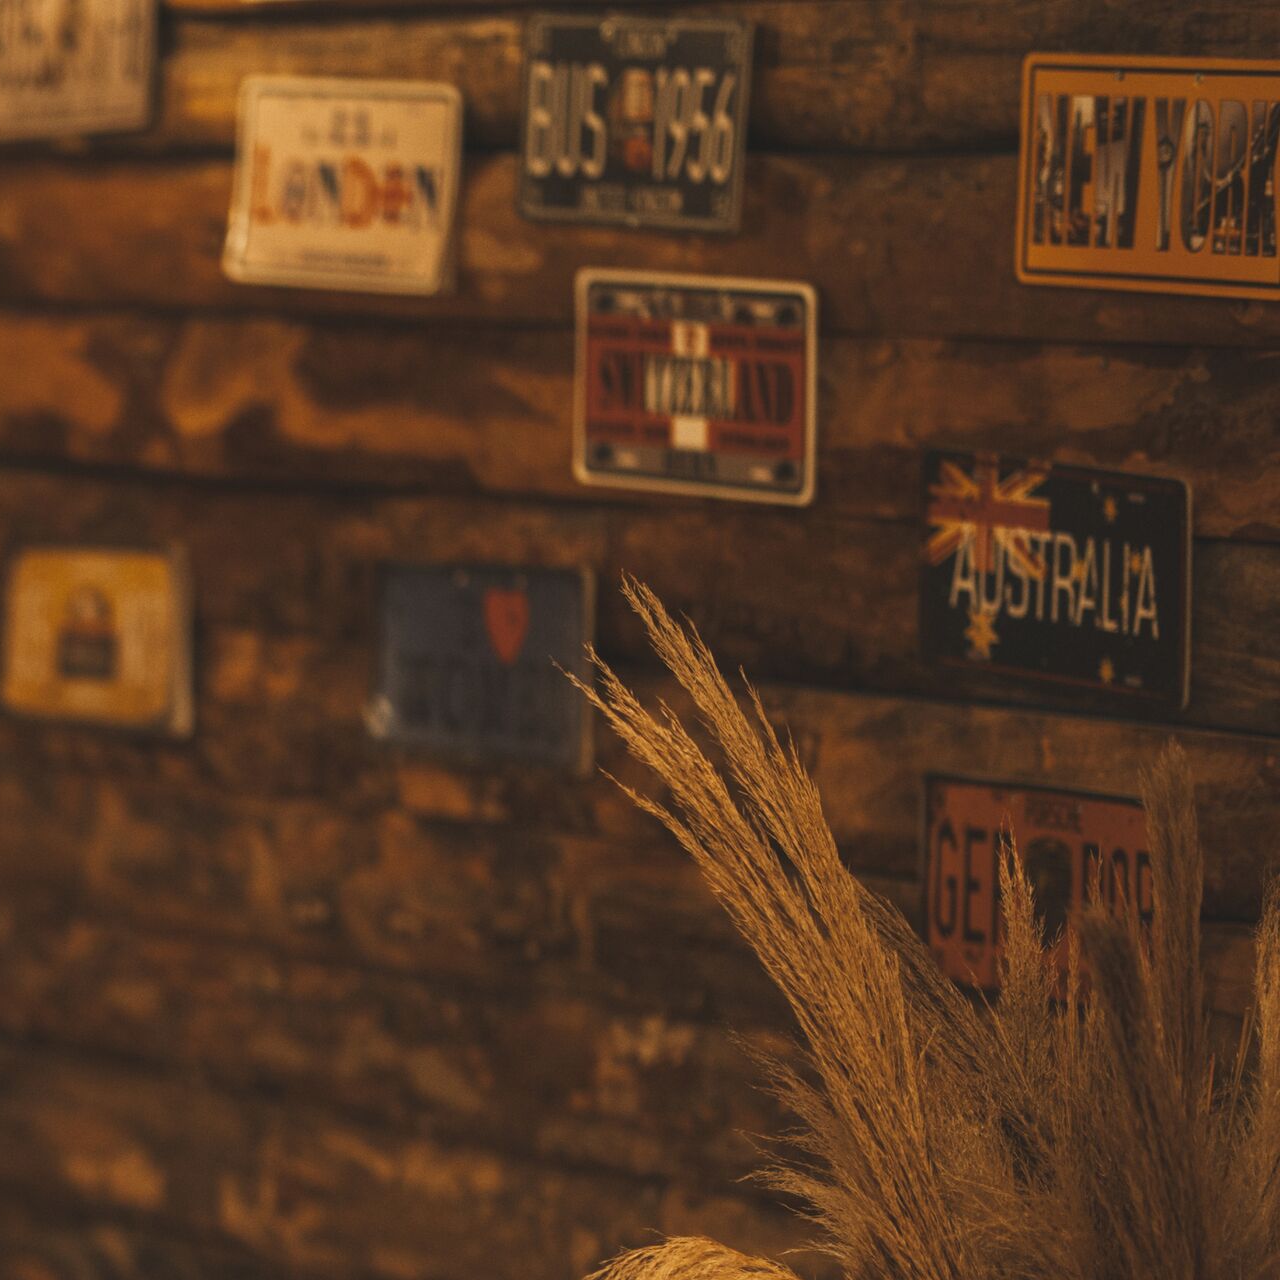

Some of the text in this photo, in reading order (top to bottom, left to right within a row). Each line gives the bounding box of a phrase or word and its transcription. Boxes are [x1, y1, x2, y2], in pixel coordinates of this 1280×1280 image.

[526, 61, 737, 184] BUS 1956
[1032, 94, 1280, 258] NEW YORK
[949, 530, 1160, 640] AUSTRALIA
